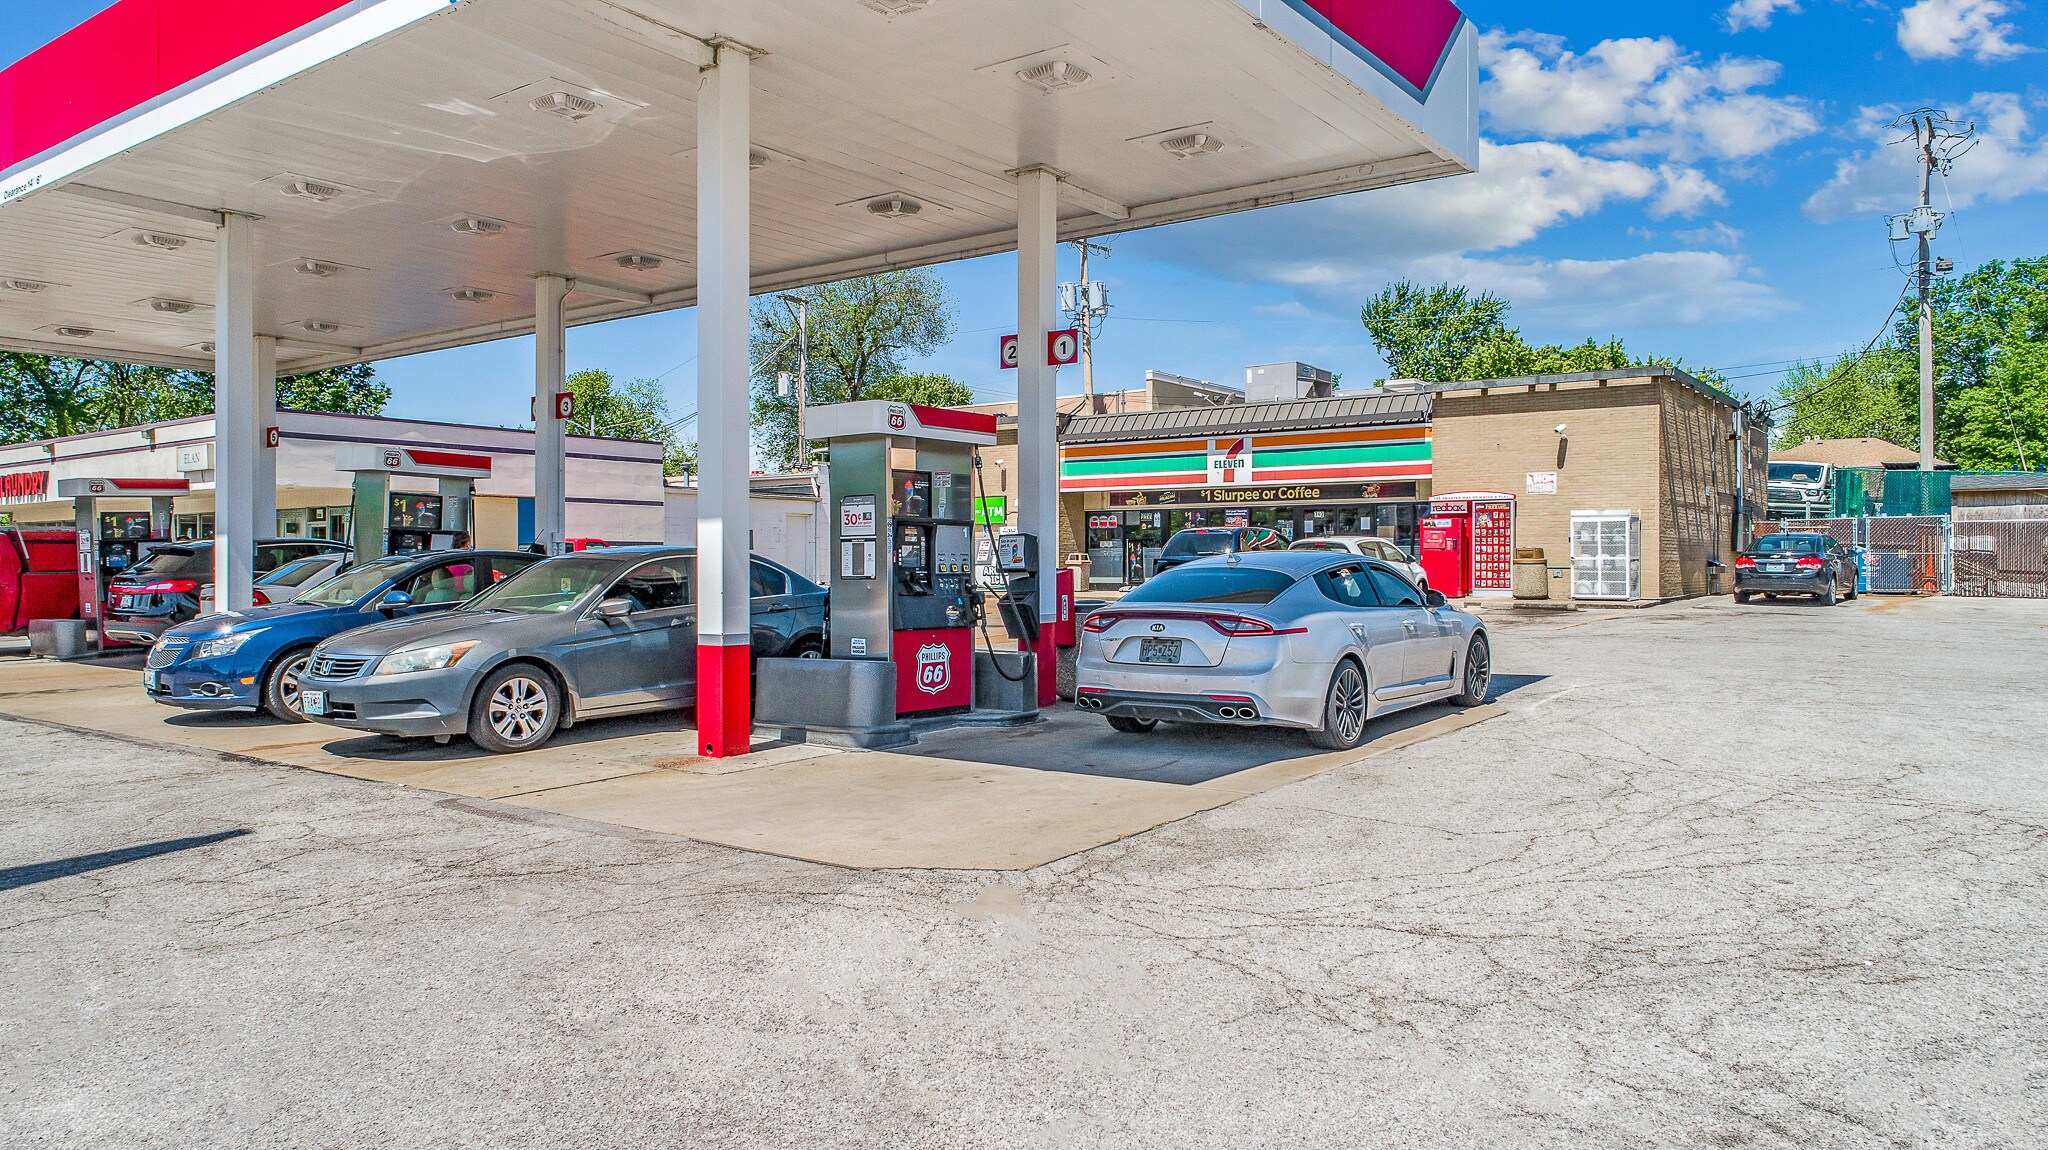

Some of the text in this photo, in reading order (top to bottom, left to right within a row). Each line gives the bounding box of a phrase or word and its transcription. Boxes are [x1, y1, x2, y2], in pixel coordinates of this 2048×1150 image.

[4, 184, 27, 199] Clearance
[1008, 346, 1017, 359] 2
[1060, 341, 1067, 354] 1
[563, 401, 569, 412] 3
[890, 415, 903, 426] 66
[271, 433, 276, 442] 5
[184, 452, 200, 464] ELAN
[386, 457, 399, 465] 66
[1214, 458, 1245, 469] ELEVEN
[0, 471, 48, 498] LAUNDRY
[1201, 489, 1211, 501] $1
[1263, 489, 1276, 499] or
[1278, 486, 1320, 499] Coffee
[394, 499, 406, 513] $1
[106, 516, 117, 527] $1
[844, 513, 861, 526] 30¢
[962, 527, 967, 538] 1
[921, 651, 946, 662] PHILLIPS
[923, 664, 944, 684] 66
